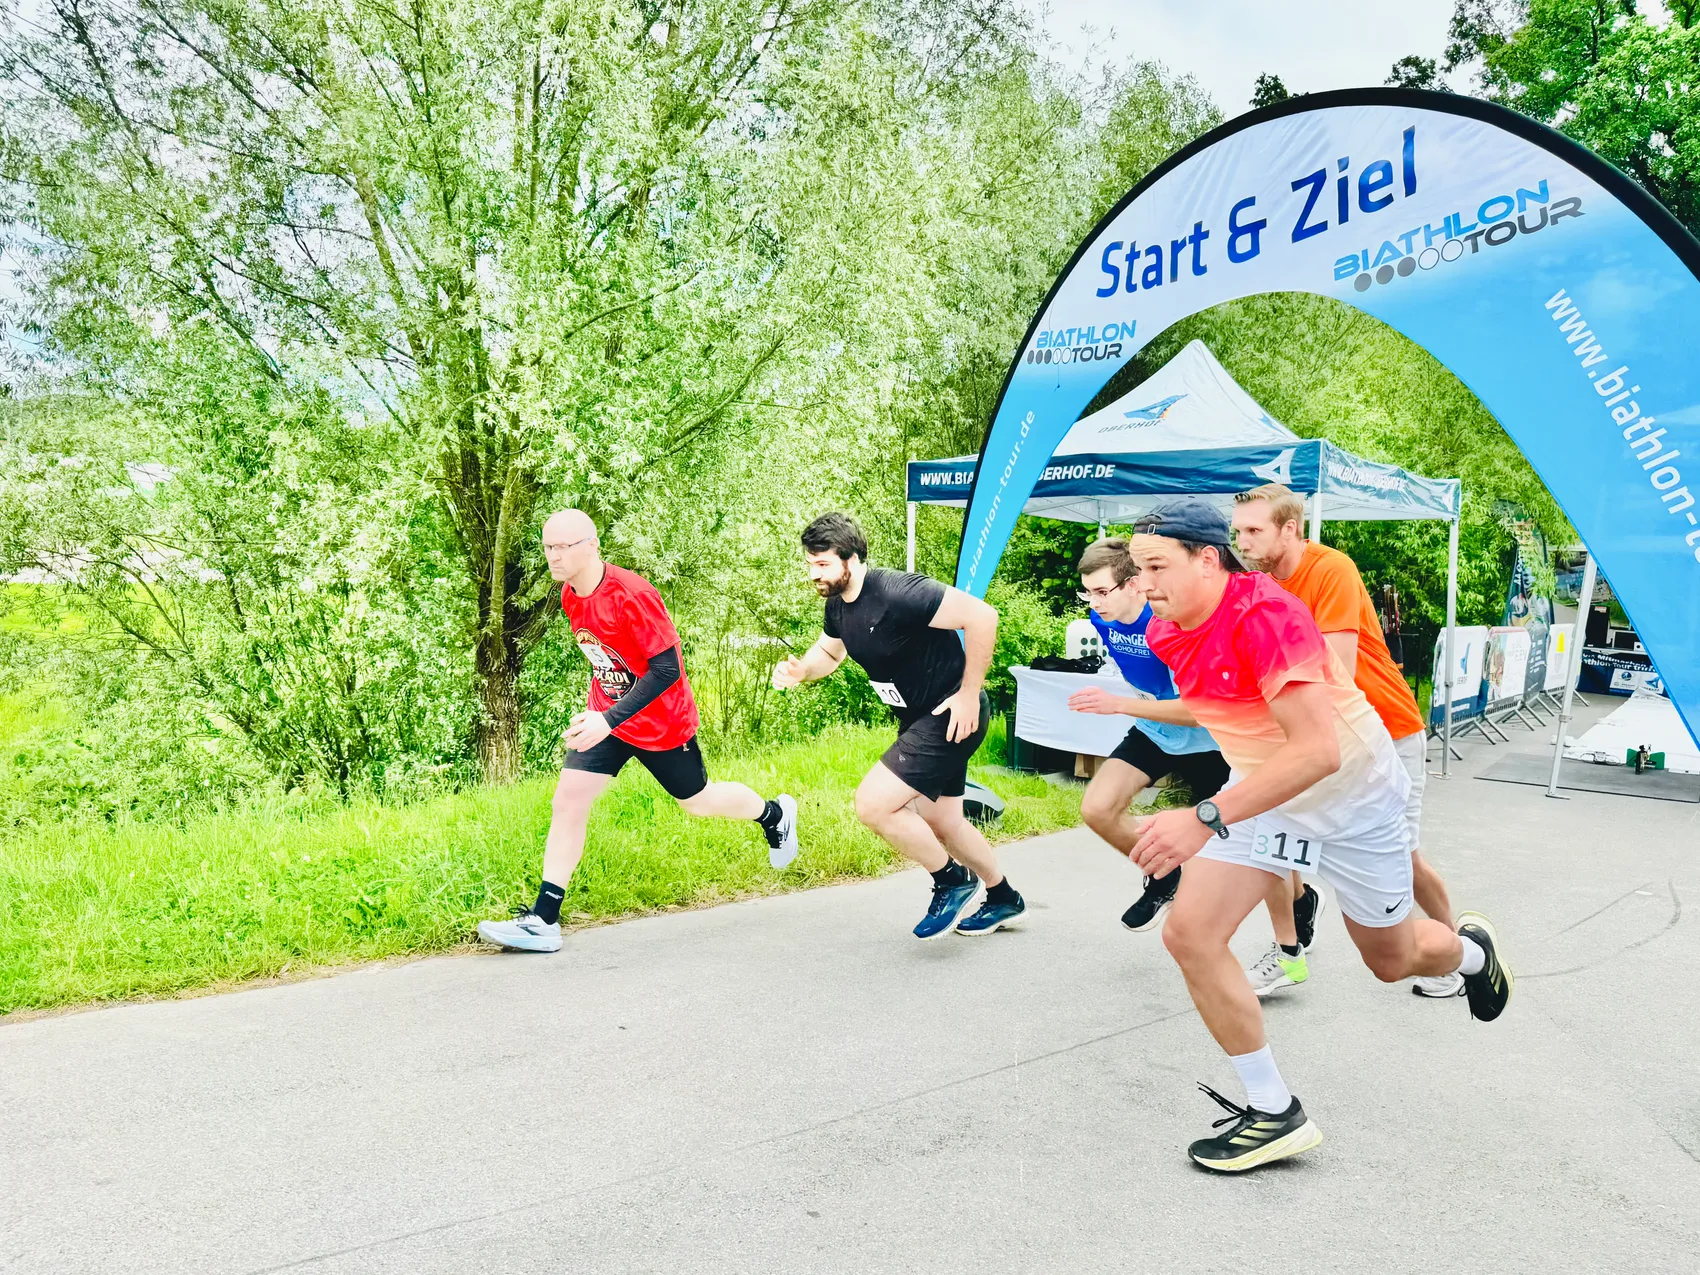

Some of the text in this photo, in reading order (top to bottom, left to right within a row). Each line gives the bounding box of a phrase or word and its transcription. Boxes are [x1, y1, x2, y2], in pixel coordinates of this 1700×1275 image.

[1096, 124, 1417, 298] Start & Ziel
[1463, 196, 1586, 254] TOUR
[1333, 179, 1550, 281] BIATHLON
[1036, 320, 1136, 348] BIATHLON
[1071, 342, 1123, 363] TOUR
[1097, 419, 1166, 433] OBERHOF
[1254, 832, 1311, 867] 311
